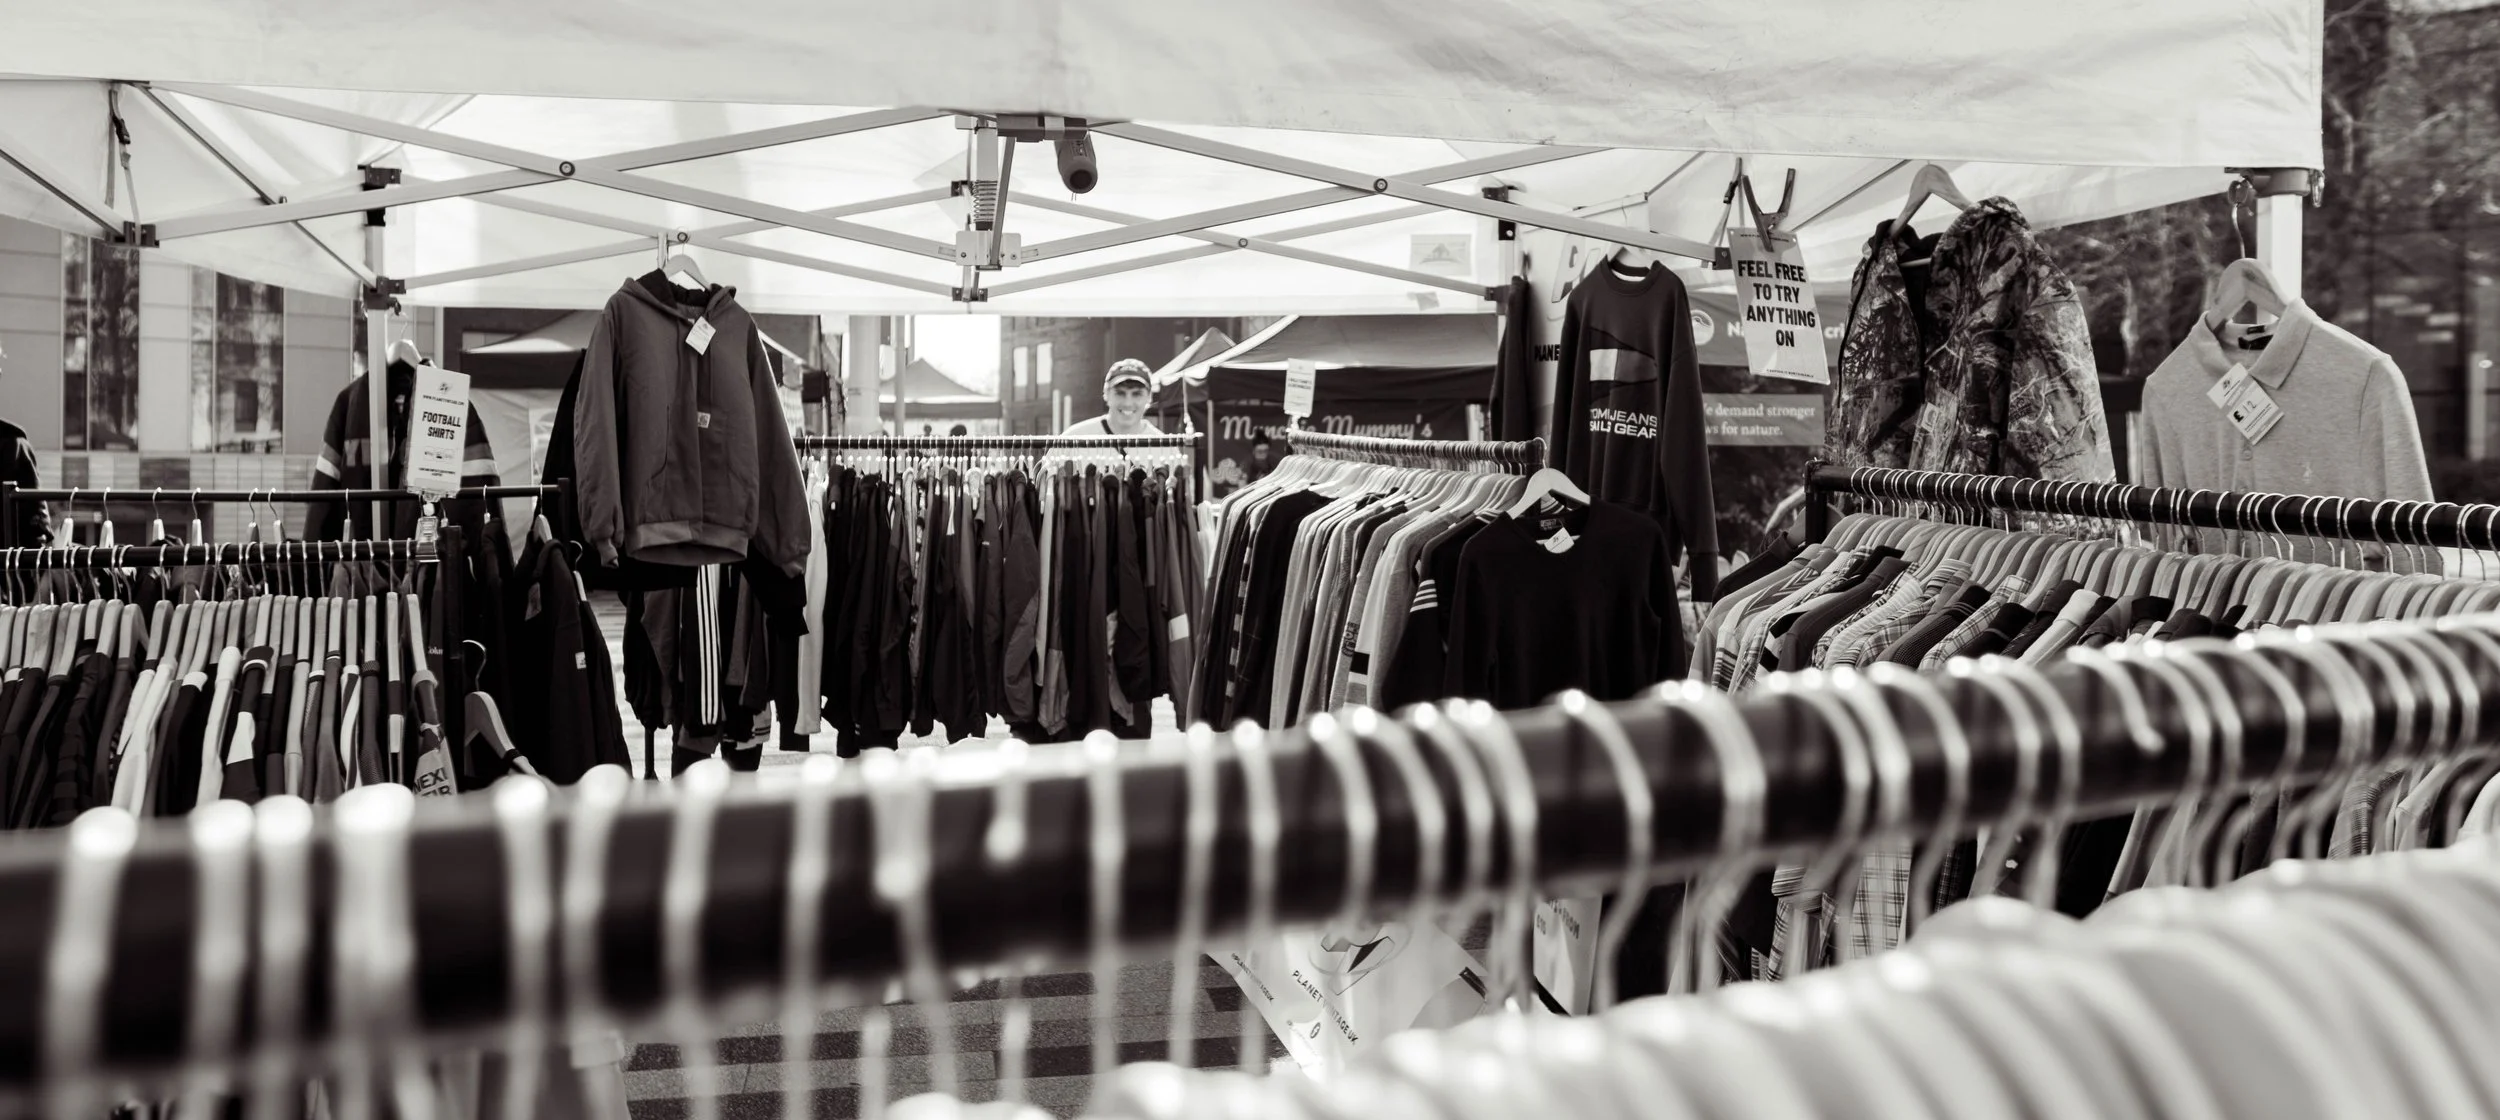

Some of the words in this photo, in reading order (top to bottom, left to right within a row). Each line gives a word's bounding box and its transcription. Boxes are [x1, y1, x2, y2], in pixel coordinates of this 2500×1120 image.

[1737, 260, 1773, 278] FEEL
[1775, 262, 1806, 283] FREE
[1753, 283, 1772, 301] TO
[1774, 284, 1800, 304] TRY
[1746, 304, 1816, 328] ANYTHING
[1775, 329, 1795, 347] ON
[422, 411, 461, 428] FOOTBALL
[1703, 402, 1713, 416] e
[1715, 402, 1764, 417] demand
[1767, 405, 1816, 421] stronger
[427, 427, 455, 440] SHIRTS
[1721, 420, 1739, 435] for
[1292, 969, 1324, 1004] PLANET
